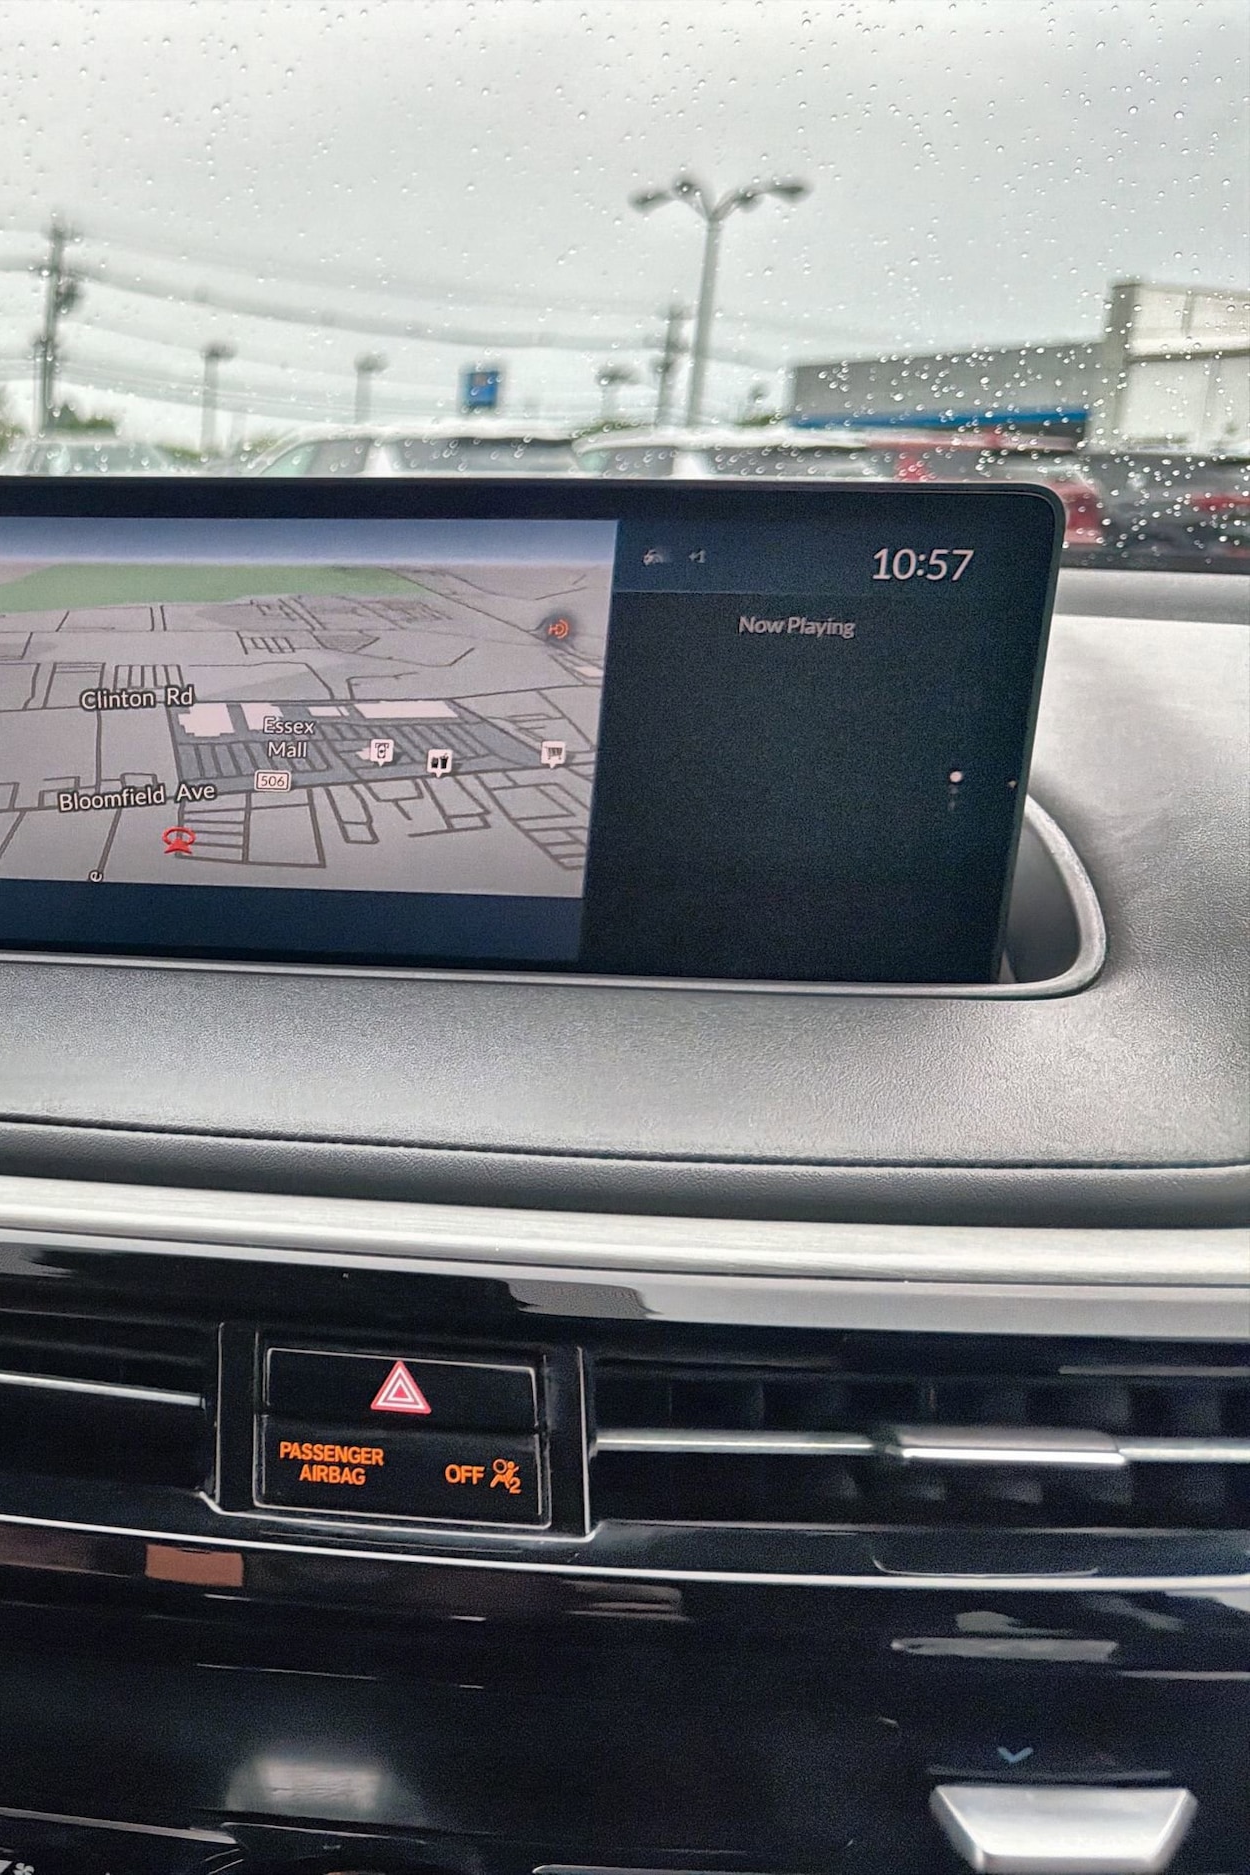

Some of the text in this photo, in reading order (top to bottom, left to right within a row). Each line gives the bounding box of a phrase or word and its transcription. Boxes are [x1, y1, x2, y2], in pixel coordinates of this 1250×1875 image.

[871, 548, 974, 581] 10:57
[738, 615, 856, 639] Now Playing
[81, 686, 193, 709] Clinton Rd
[264, 717, 315, 735] Essex
[268, 741, 308, 758] Mall
[260, 775, 285, 787] 506
[58, 783, 215, 812] Bloomfield Ave
[279, 1441, 385, 1466] PASSENGER
[299, 1465, 366, 1486] AIRBAG
[444, 1463, 485, 1486] OFF
